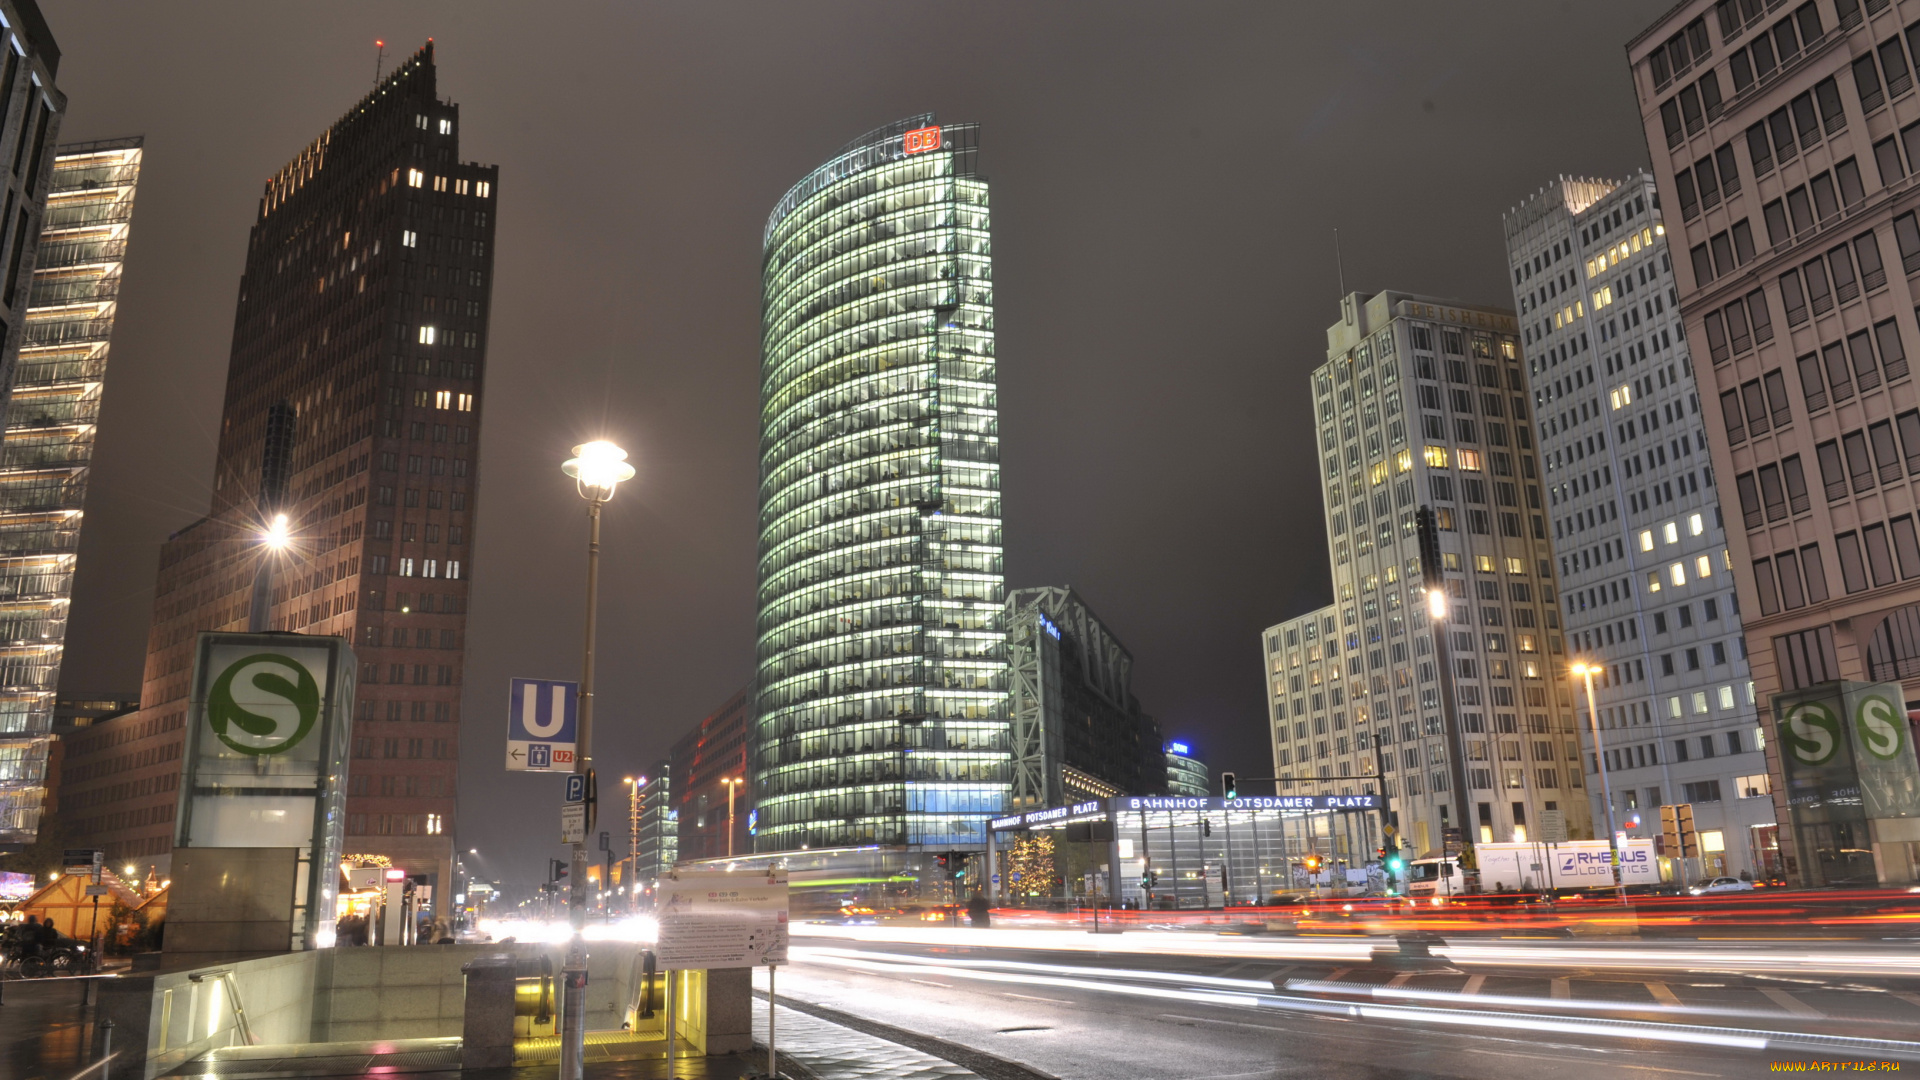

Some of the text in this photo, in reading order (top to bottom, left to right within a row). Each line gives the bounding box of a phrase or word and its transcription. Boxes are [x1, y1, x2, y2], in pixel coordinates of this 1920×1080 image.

[908, 129, 937, 152] DB
[1411, 303, 1512, 329] BEISHEIM
[226, 661, 301, 749] S
[522, 683, 566, 738] U
[1790, 705, 1833, 761] S
[1862, 699, 1899, 756] S
[555, 751, 571, 762] U2
[569, 778, 581, 800] P
[1130, 798, 1208, 809] BAHNHOF
[1327, 796, 1372, 807] PLATZ
[992, 801, 1098, 829] BAHNHOF POTSDAMER PLATZ
[573, 850, 589, 862] 352
[1579, 864, 1649, 876] LOGITICS
